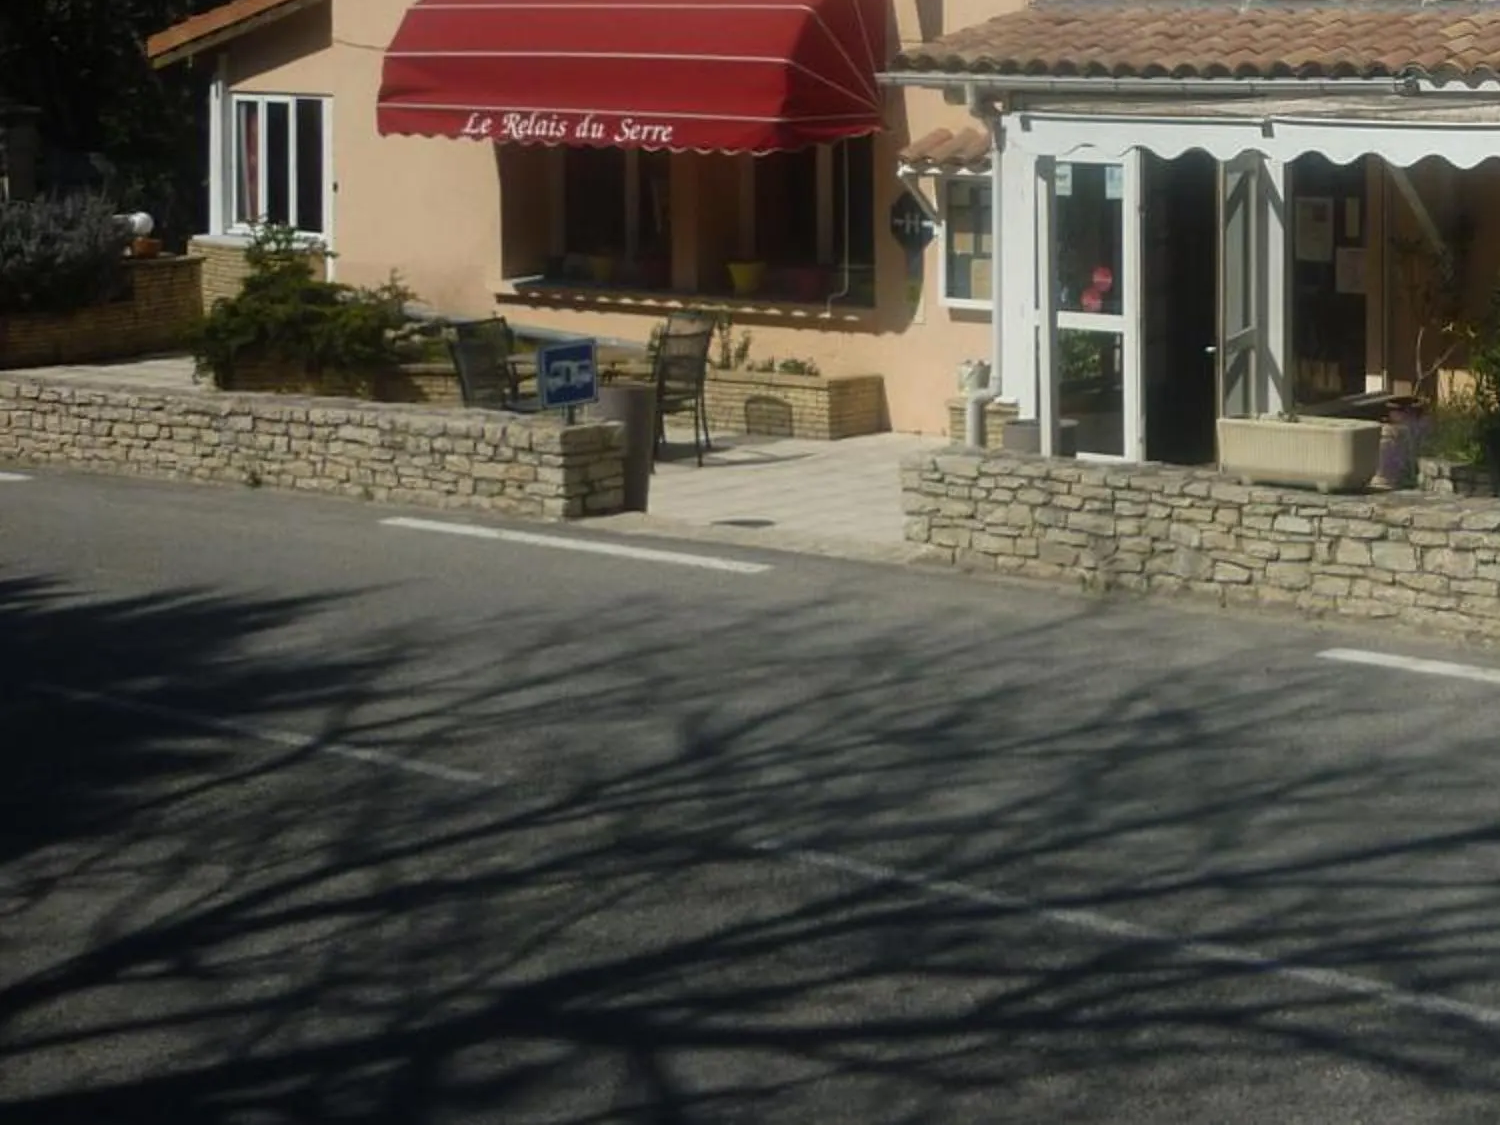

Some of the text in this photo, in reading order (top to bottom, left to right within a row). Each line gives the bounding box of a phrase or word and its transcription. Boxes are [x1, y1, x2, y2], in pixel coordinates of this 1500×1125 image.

[462, 109, 674, 143] Le Relais du Serre
